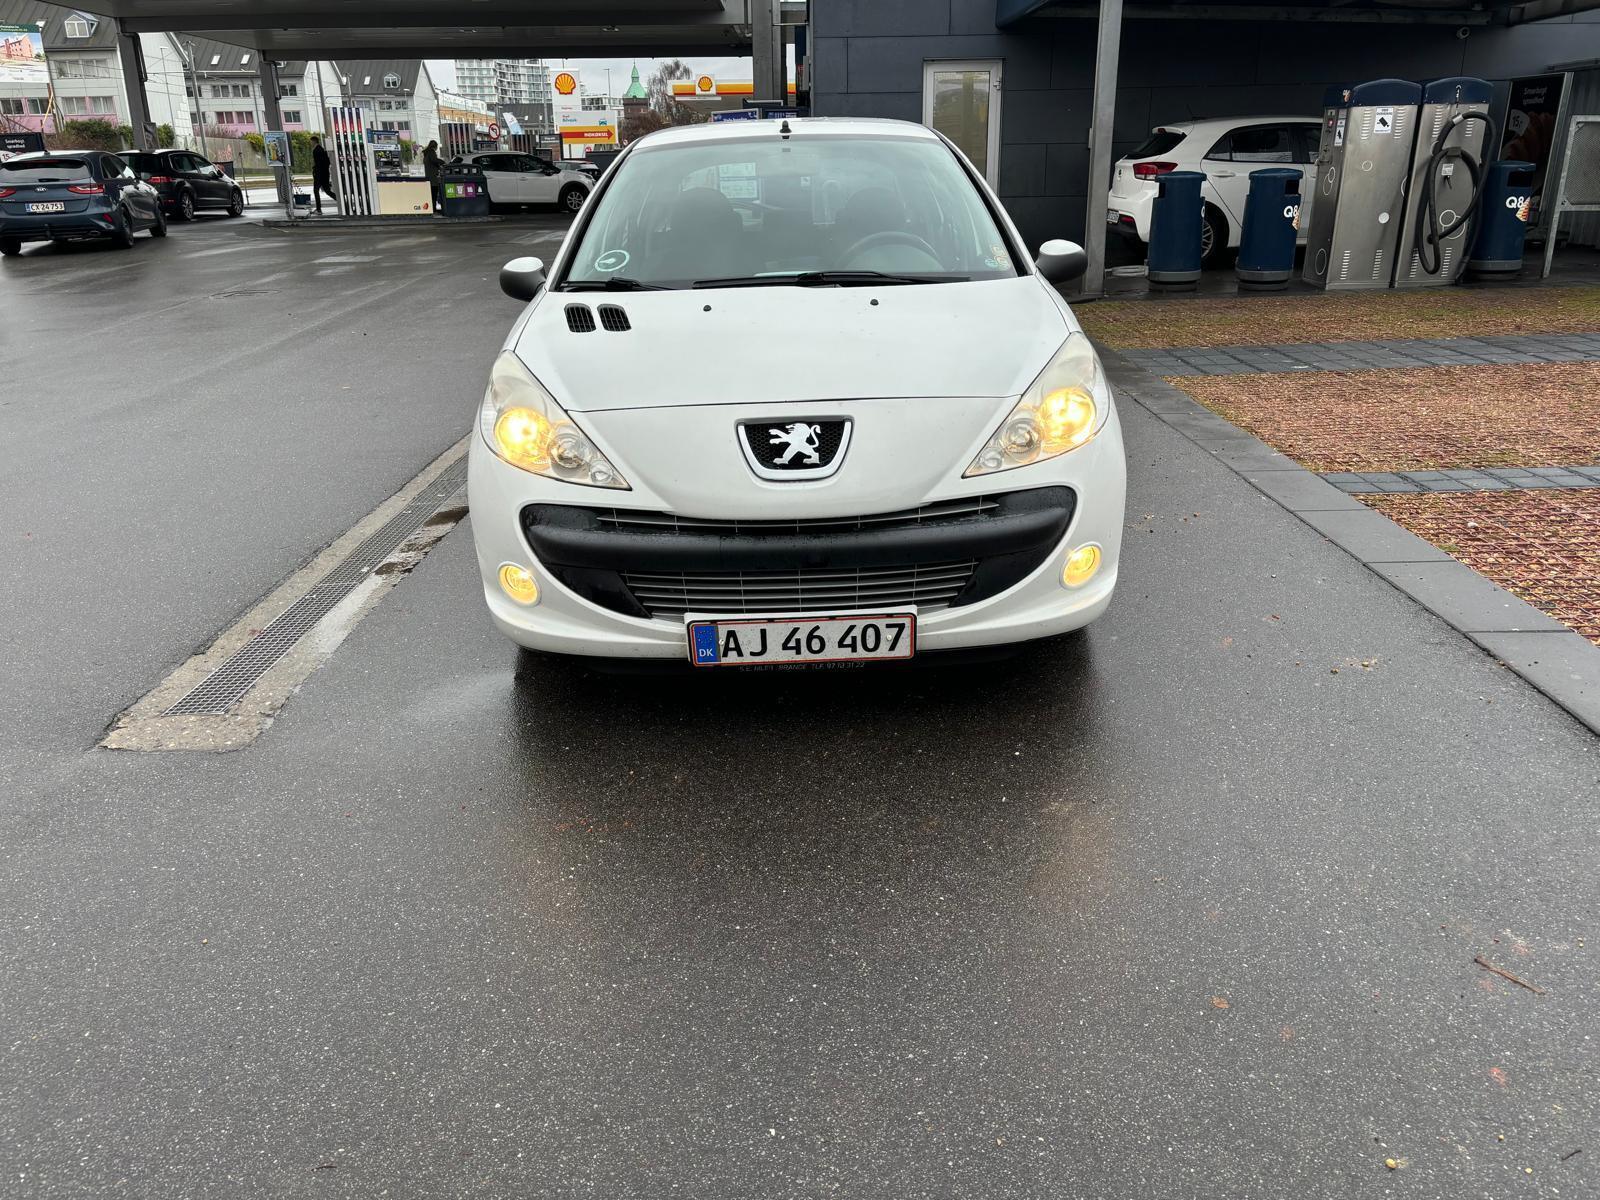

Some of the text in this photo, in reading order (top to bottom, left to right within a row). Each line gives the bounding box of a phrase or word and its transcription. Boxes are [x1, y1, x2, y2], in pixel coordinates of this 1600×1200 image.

[1506, 196, 1525, 209] Q8
[721, 622, 906, 658] AJ 46 407
[699, 648, 714, 657] DK
